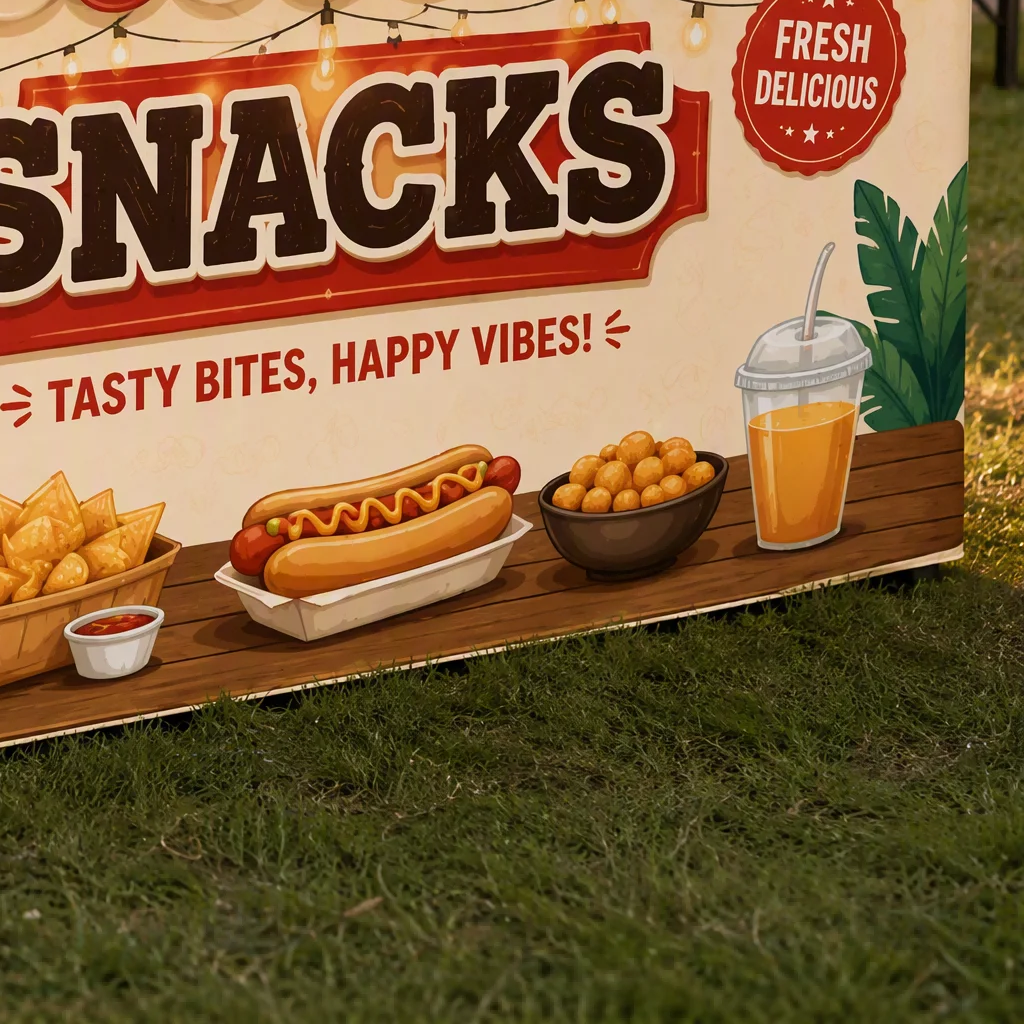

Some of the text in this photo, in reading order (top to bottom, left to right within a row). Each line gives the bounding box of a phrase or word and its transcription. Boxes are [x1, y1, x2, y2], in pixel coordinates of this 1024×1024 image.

[774, 19, 872, 64] FRESH
[754, 69, 879, 110] DELICIOUS
[47, 313, 593, 423] TASTY BITES, HAPPY VIBES!
